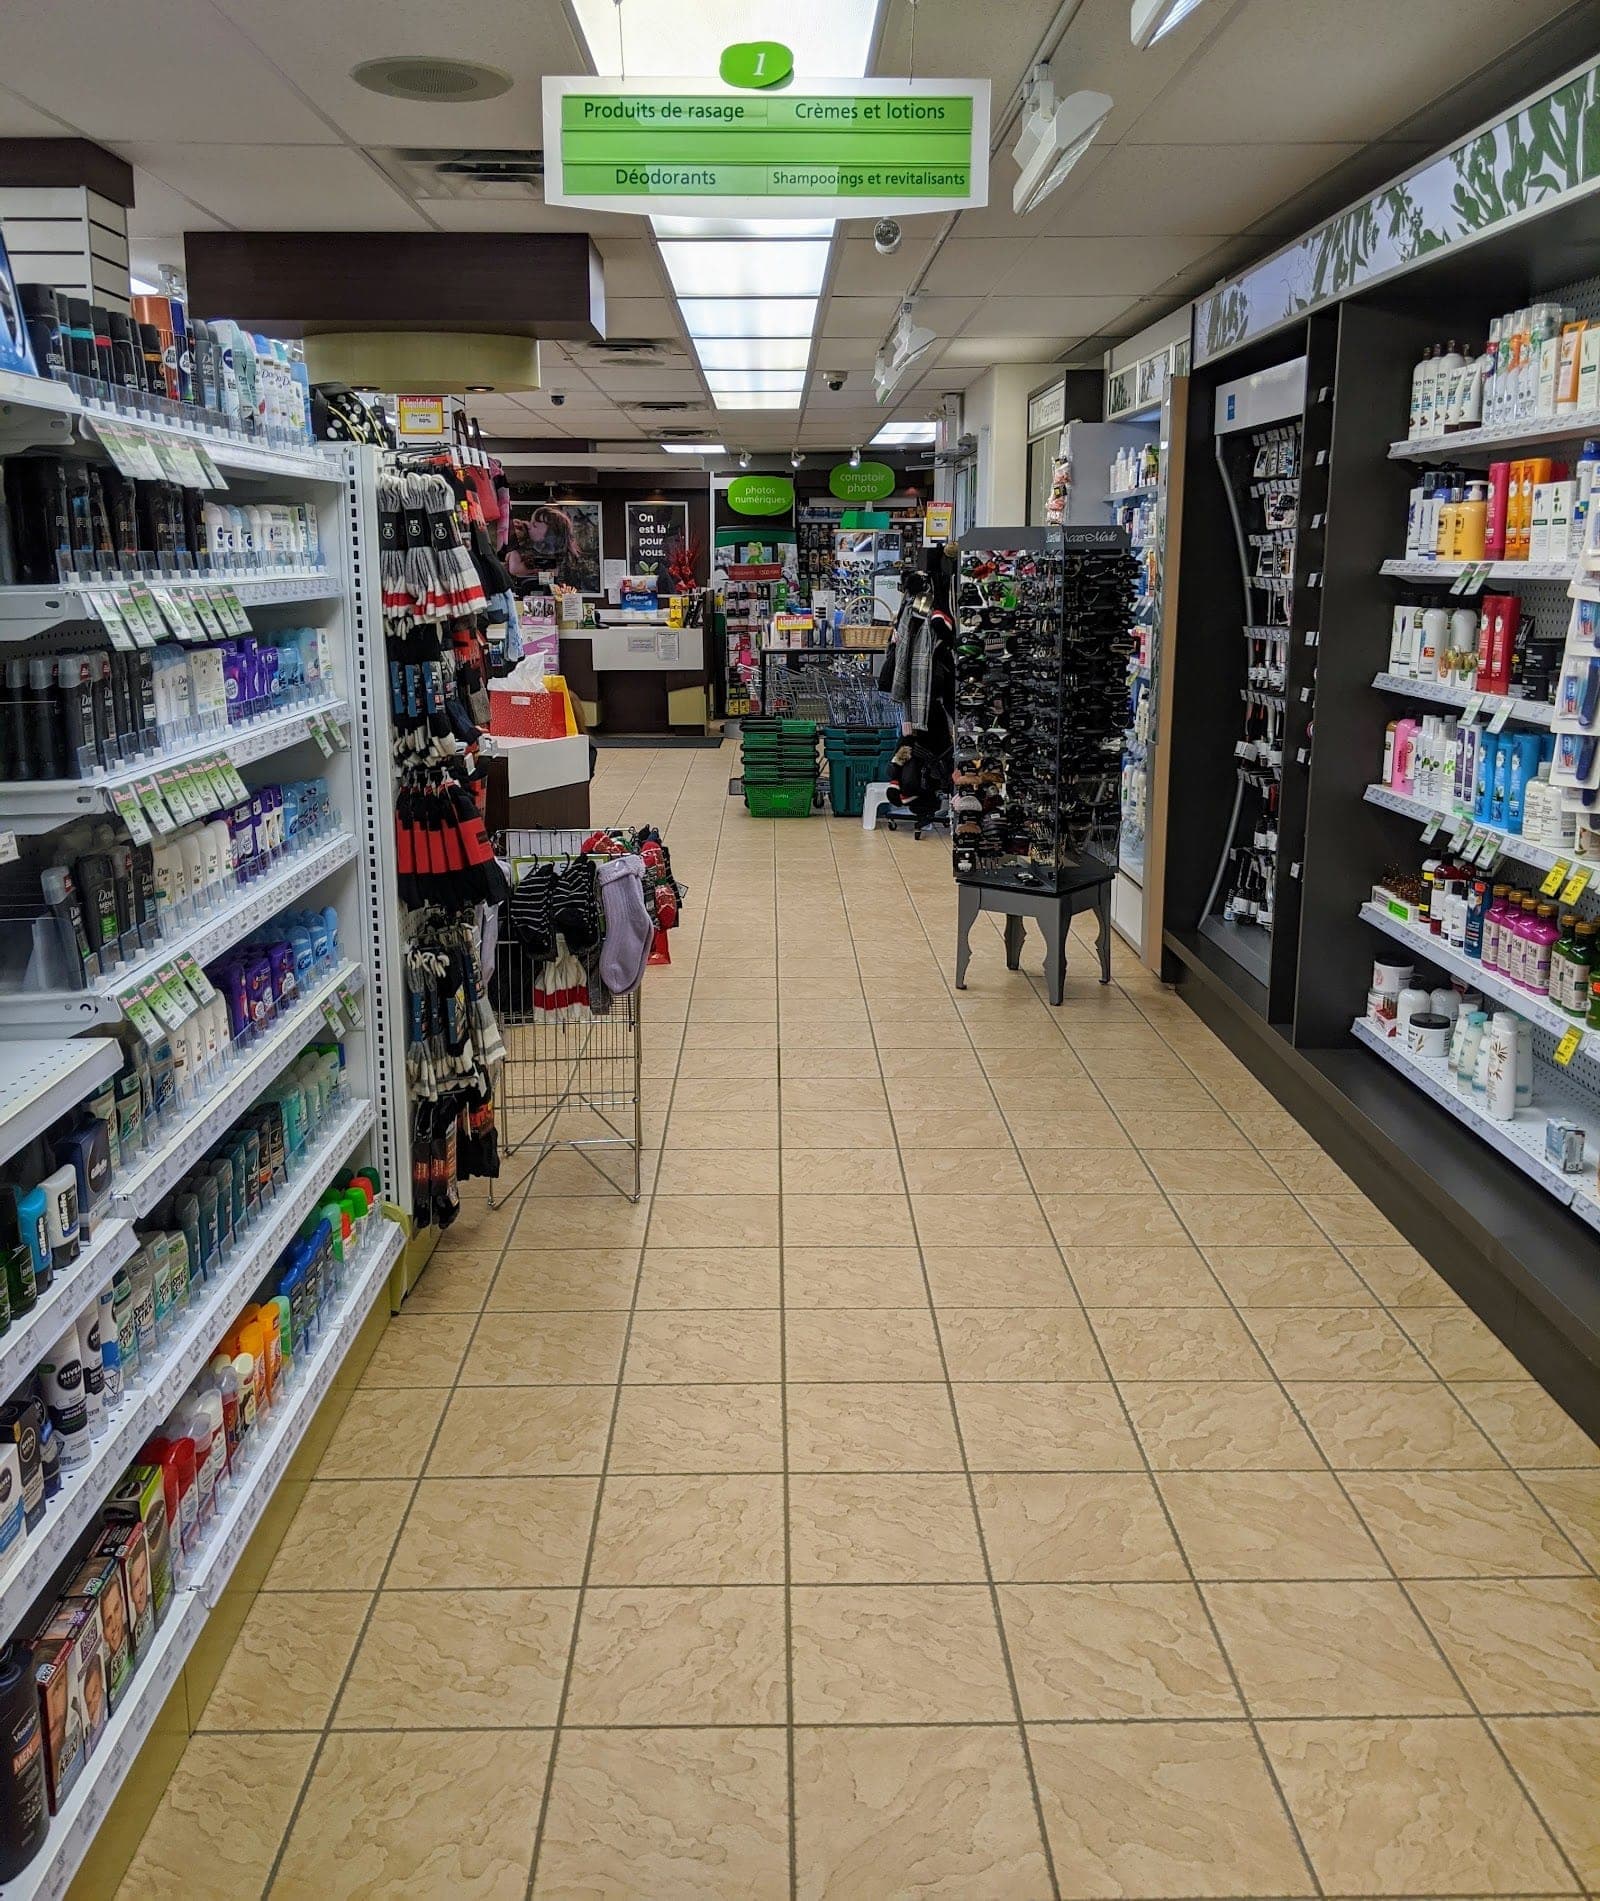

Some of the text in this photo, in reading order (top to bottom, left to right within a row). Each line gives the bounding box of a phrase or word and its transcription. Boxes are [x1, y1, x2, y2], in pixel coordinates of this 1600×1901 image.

[753, 52, 766, 77] 1
[584, 101, 744, 122] Produits de rasage
[795, 102, 945, 120] Crèmes et lotions
[615, 168, 717, 186] Déodorants
[773, 170, 966, 188] Shampooings et revitalisants
[840, 472, 885, 483] comptoir
[745, 486, 776, 495] photos
[847, 483, 878, 494] photo
[735, 495, 786, 505] numériques
[638, 513, 654, 522] On
[638, 524, 667, 534] est là
[639, 537, 664, 547] pour
[639, 549, 666, 557] vous.
[60, 1364, 81, 1380] NIVEA
[14, 1744, 34, 1772] MEN
